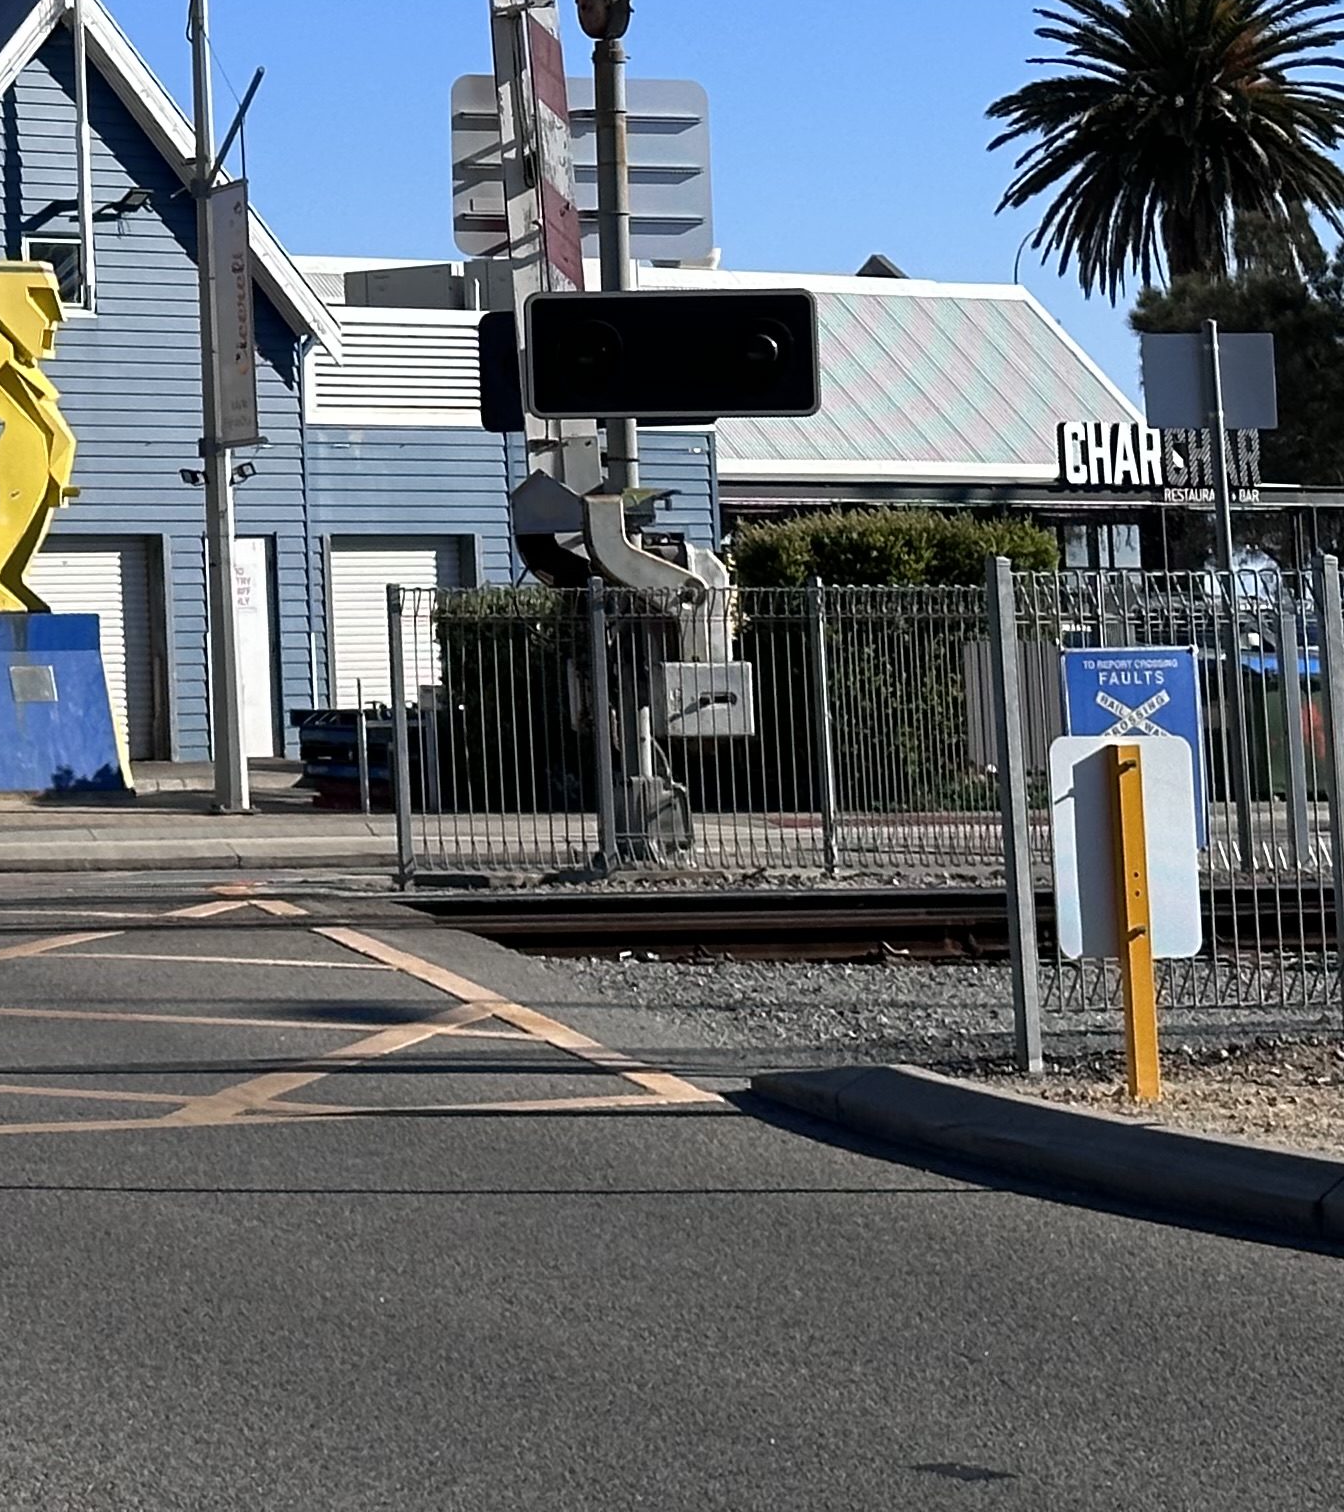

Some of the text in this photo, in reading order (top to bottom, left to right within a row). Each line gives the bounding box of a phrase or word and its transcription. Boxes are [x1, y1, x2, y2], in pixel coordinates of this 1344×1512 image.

[1063, 421, 1162, 485] CHAR
[1164, 488, 1215, 502] RESTAURA
[1083, 658, 1178, 669] TO REPORT CROSSING
[1098, 670, 1165, 686] FAULTS
[1099, 694, 1125, 716] RAIL
